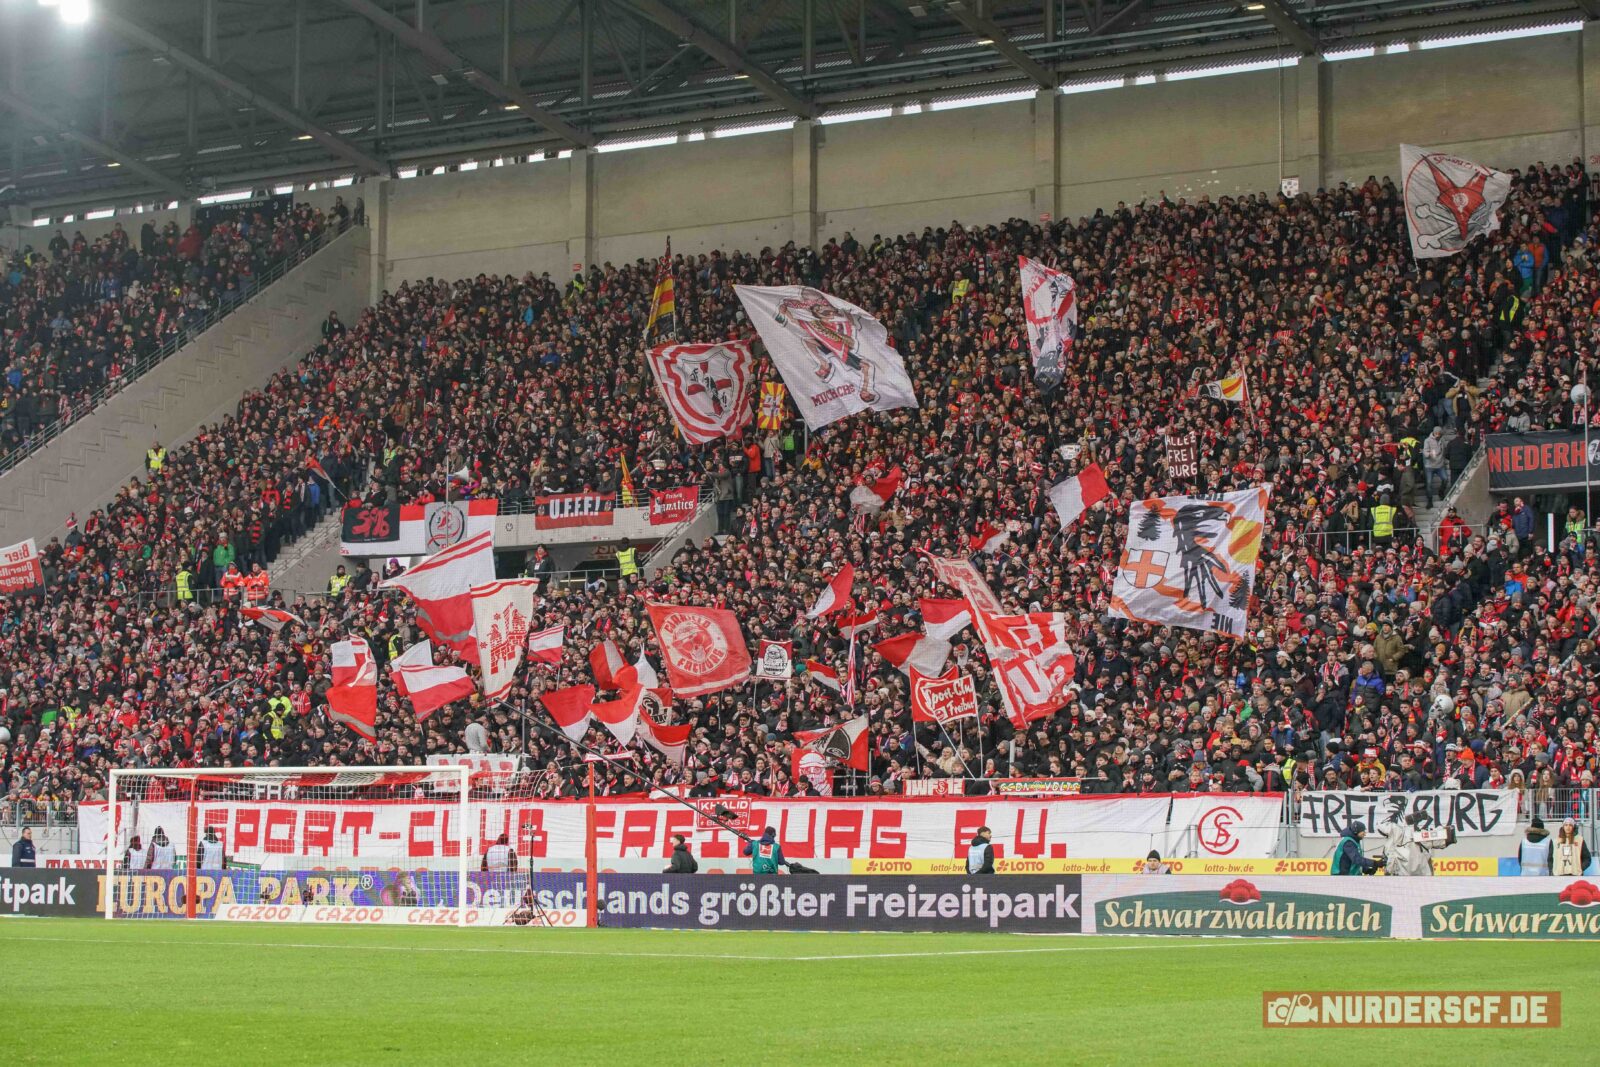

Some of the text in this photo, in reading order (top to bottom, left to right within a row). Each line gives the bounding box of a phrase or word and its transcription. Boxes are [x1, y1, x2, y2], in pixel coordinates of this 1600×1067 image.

[1165, 431, 1197, 446] ALLEZ
[1167, 447, 1195, 462] FREI
[1169, 462, 1198, 478] BURG
[550, 496, 601, 519] U.F.F.F.!
[700, 800, 749, 811] KHALID
[879, 861, 912, 872] LOTTO
[1009, 861, 1045, 872] LOTTO
[1062, 862, 1111, 873] lotto-bw.de
[1204, 863, 1254, 874] lotto-bw.de
[1290, 861, 1328, 872] LOTTO
[1440, 860, 1479, 872] LOTTO
[464, 880, 1081, 928] Deuschlands größter Freizeitpark
[226, 906, 291, 920] CAZOO
[314, 907, 384, 922] CAZOO
[1103, 900, 1382, 931] Schwarzwaldmilch
